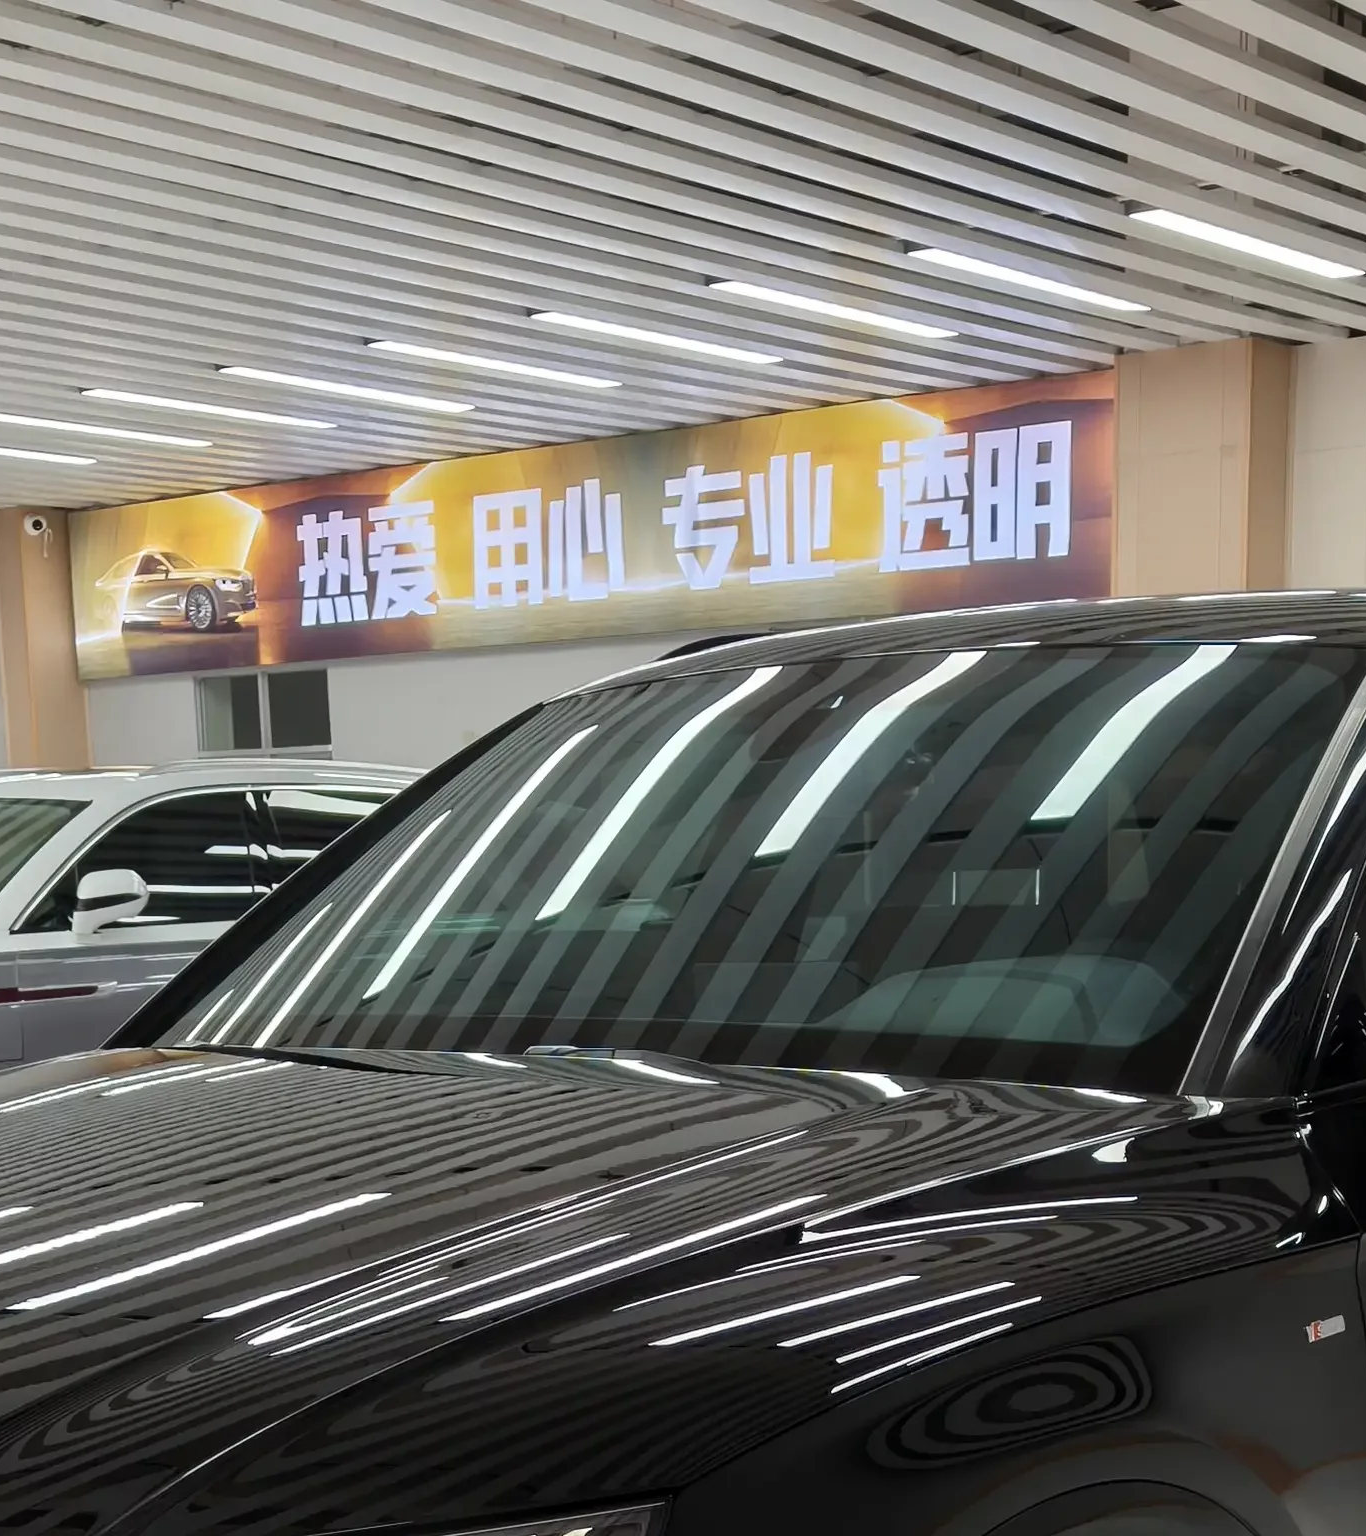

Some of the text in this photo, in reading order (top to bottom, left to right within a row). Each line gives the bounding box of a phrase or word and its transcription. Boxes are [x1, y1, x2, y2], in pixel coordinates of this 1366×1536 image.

[295, 419, 1074, 627] 热爱 用心 专业 透明
